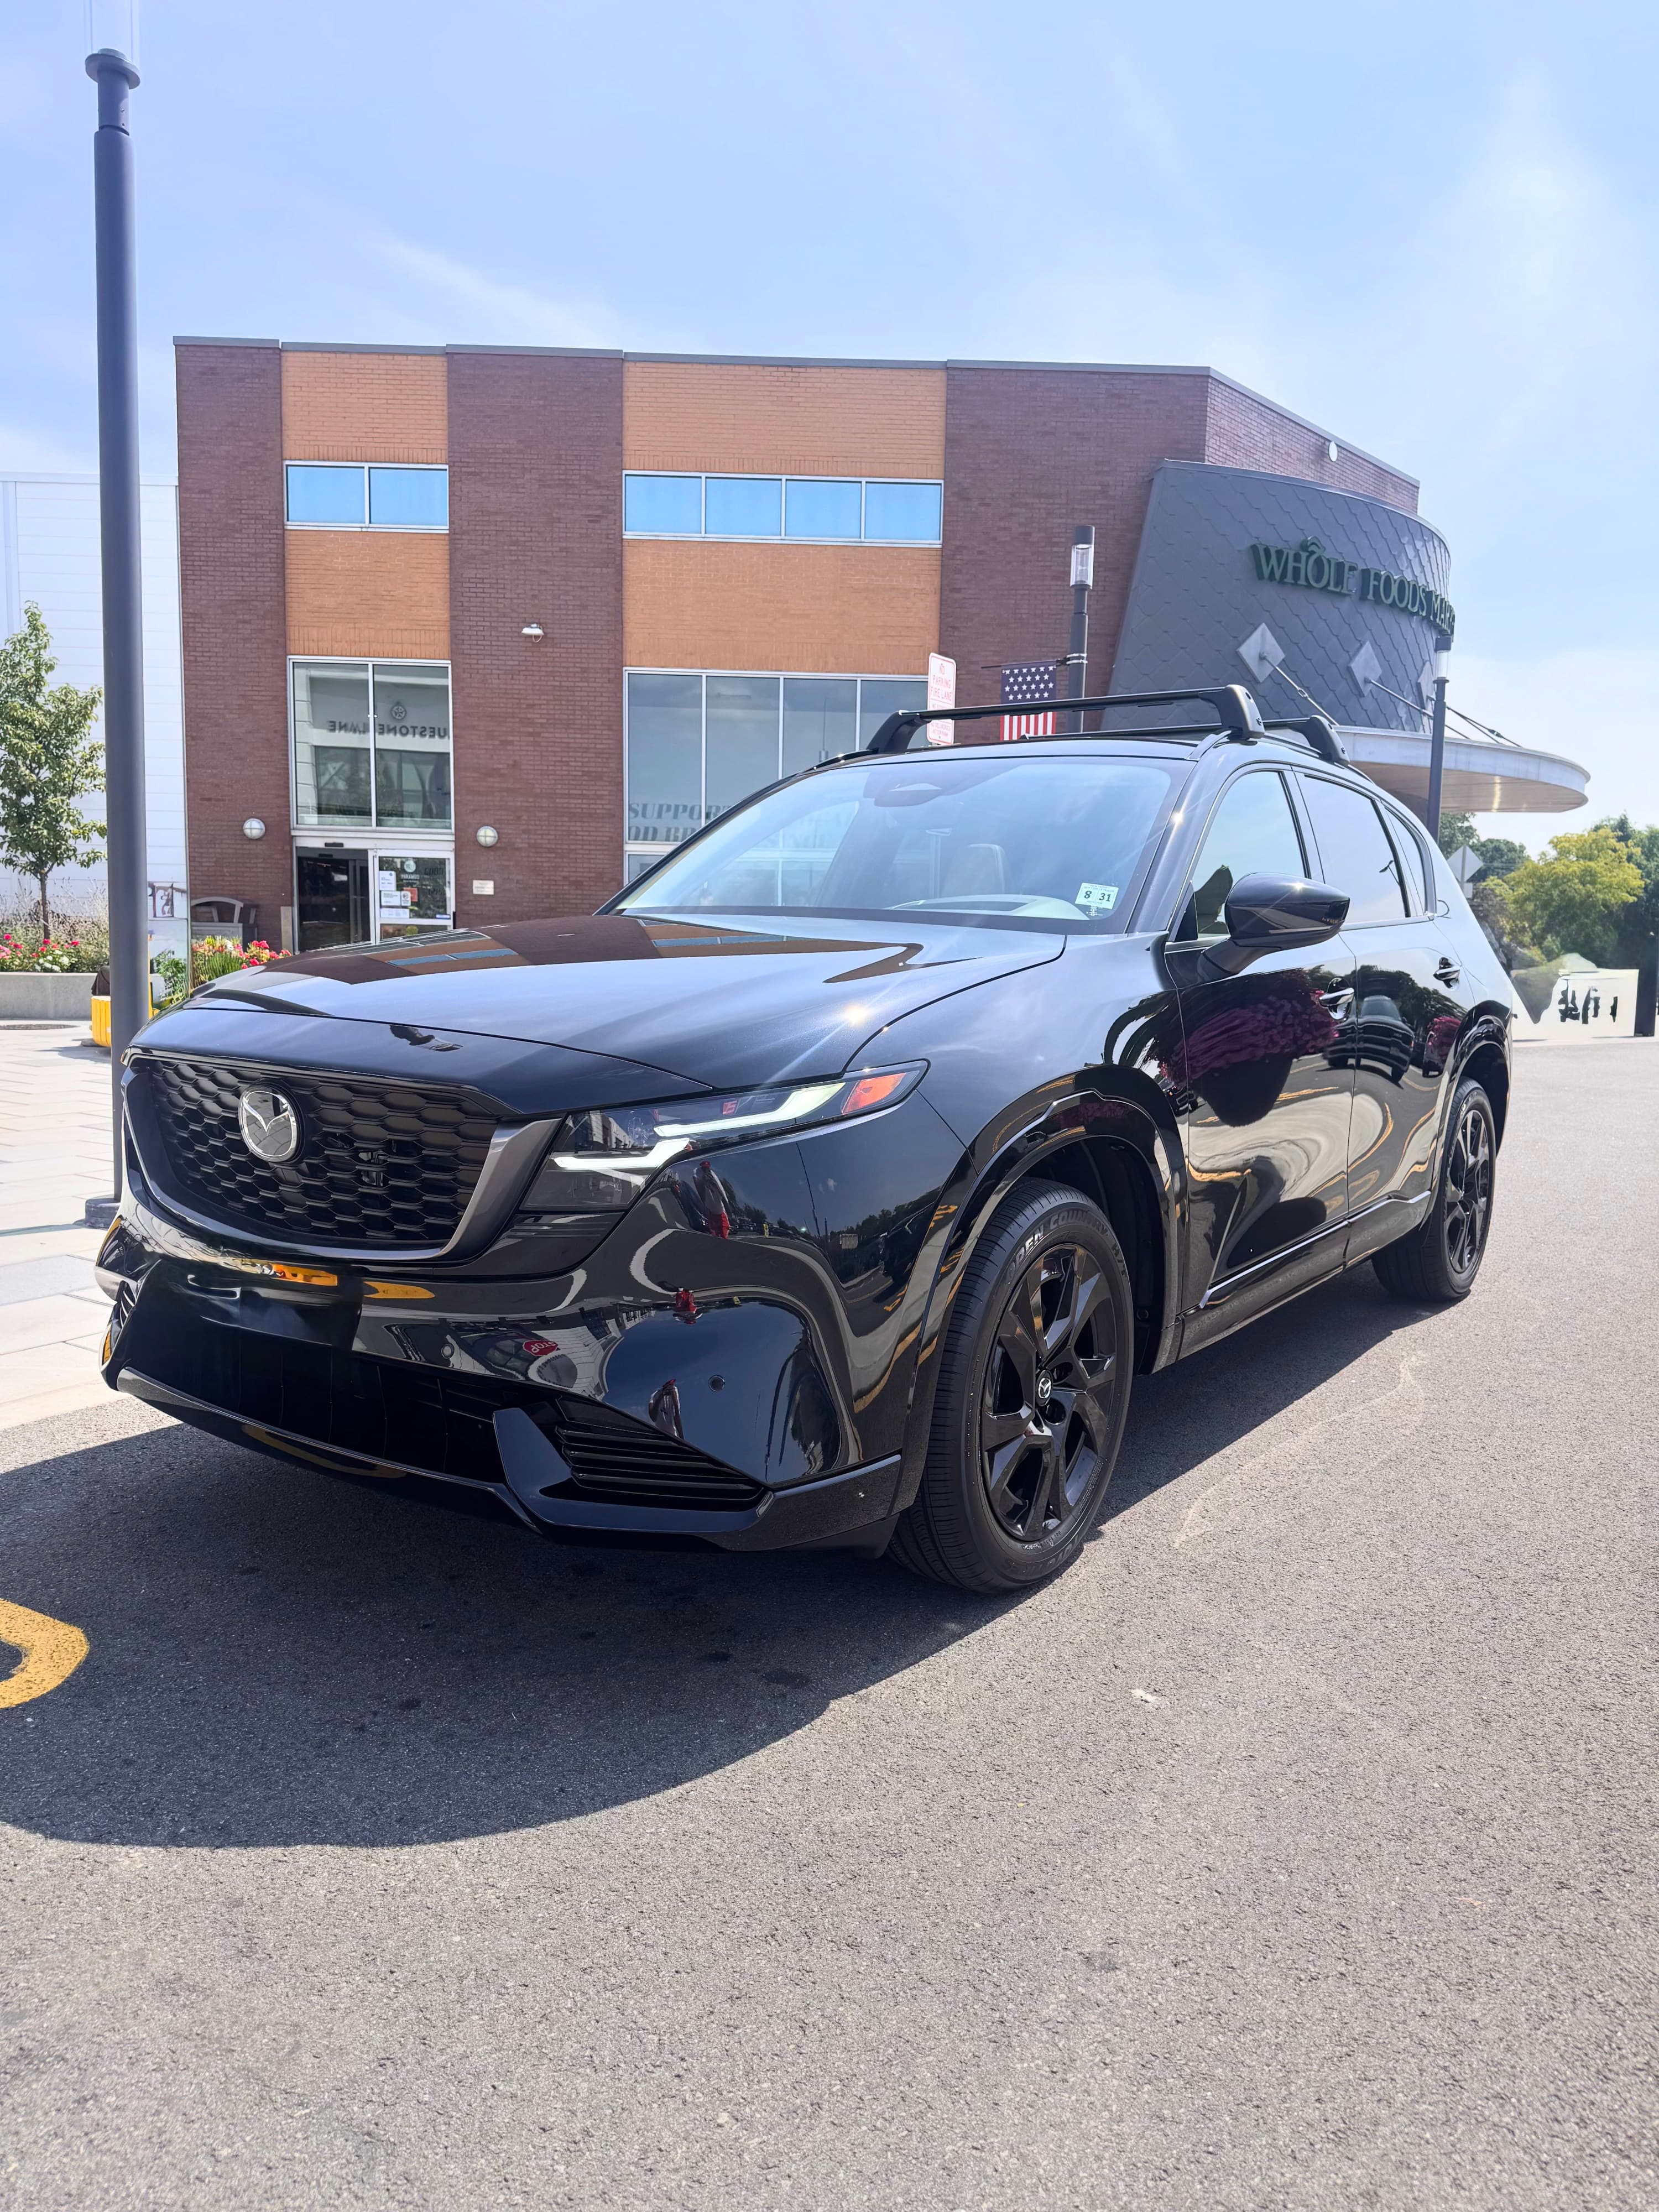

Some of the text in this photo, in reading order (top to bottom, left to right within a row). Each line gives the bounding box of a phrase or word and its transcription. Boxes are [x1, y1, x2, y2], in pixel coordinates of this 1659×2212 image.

[1250, 536, 1358, 596] WHOLE
[1361, 568, 1427, 616] FOODS
[933, 675, 951, 689] PARKING
[941, 690, 952, 701] LANE
[1084, 890, 1111, 902] 8 31
[1008, 1224, 1044, 1277] OPEN
[1050, 1208, 1108, 1236] COUNTRY
[531, 1342, 556, 1353] STOP
